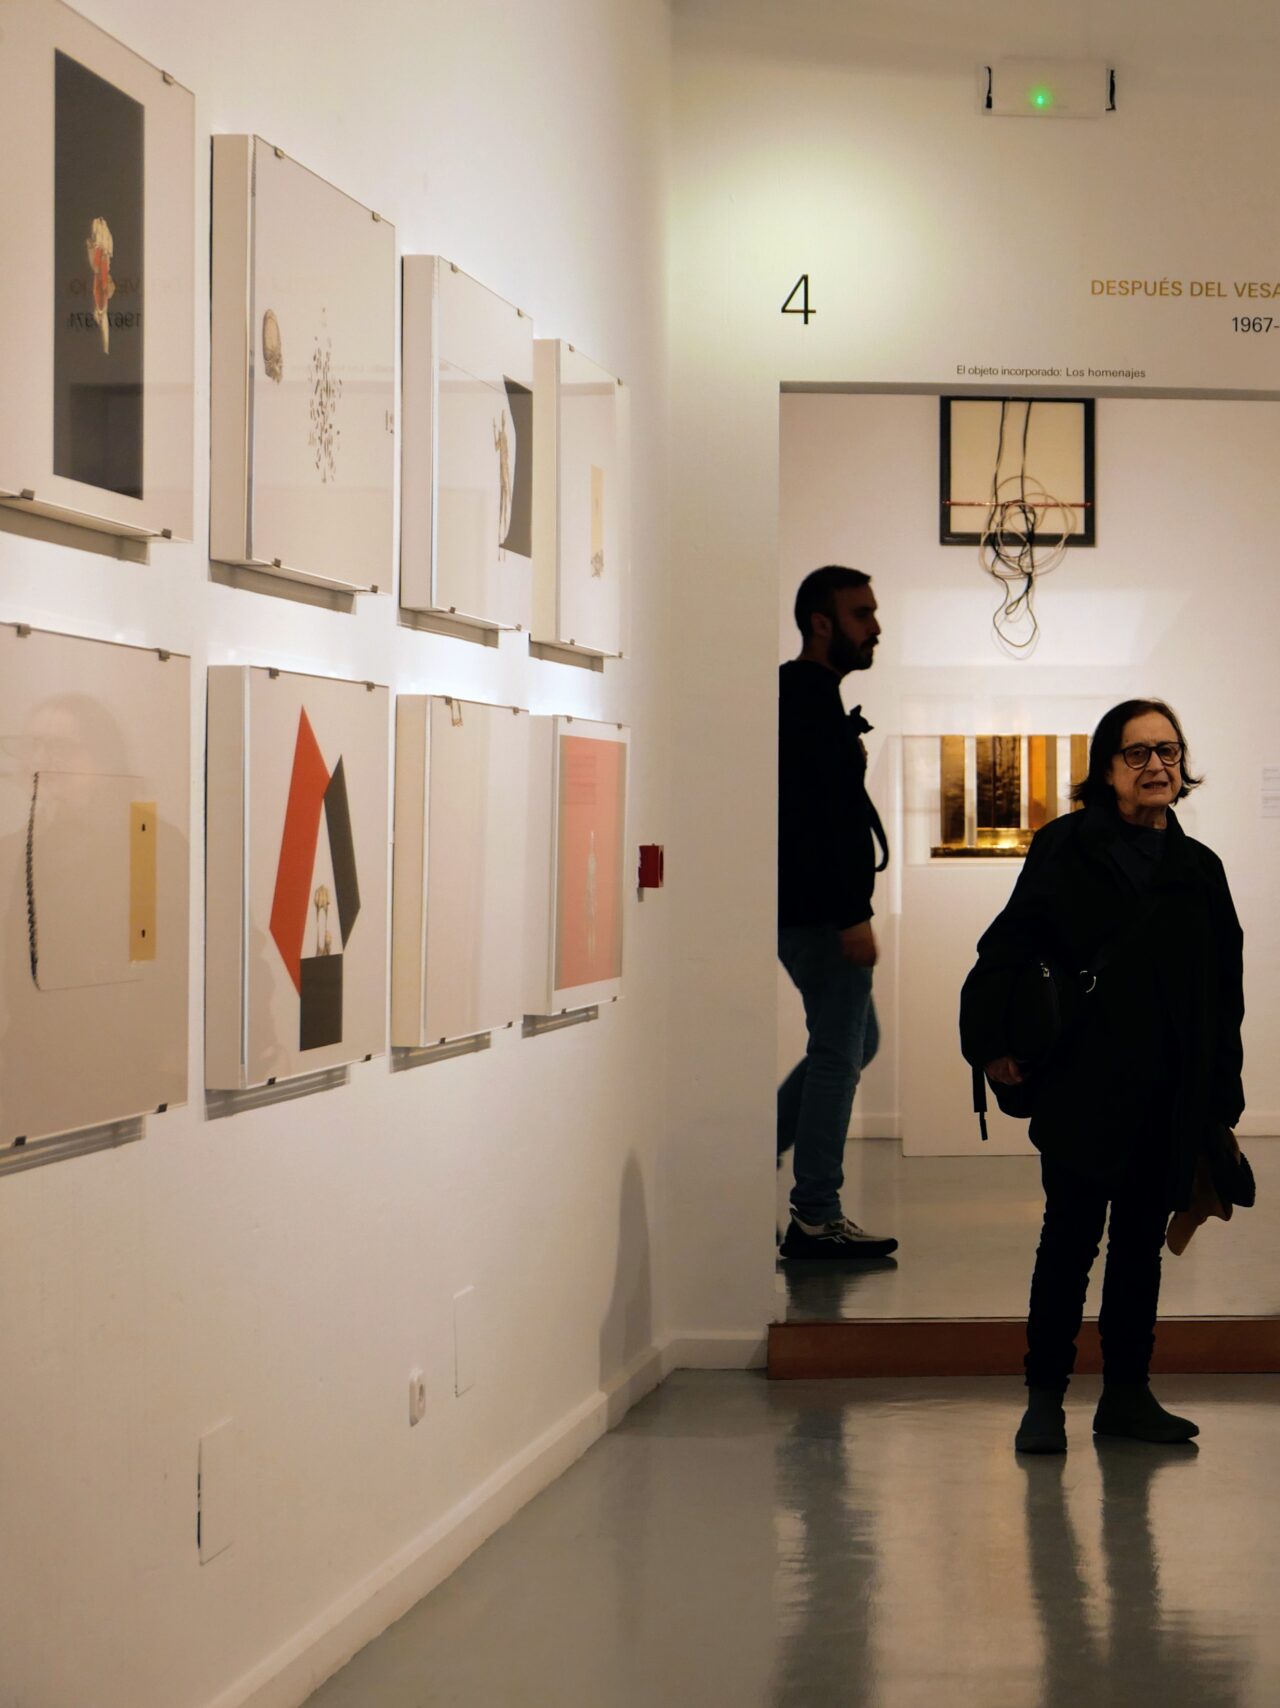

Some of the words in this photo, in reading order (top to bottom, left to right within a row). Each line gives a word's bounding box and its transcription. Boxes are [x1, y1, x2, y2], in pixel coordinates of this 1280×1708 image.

[1090, 276, 1183, 297] DESPUÉS
[1189, 281, 1228, 298] DEL
[780, 273, 817, 325] 4
[956, 364, 966, 376] El
[968, 365, 999, 378] objeto
[1000, 365, 1063, 378] incorporado:
[1065, 367, 1085, 378] Los
[1087, 367, 1146, 380] homenajes
